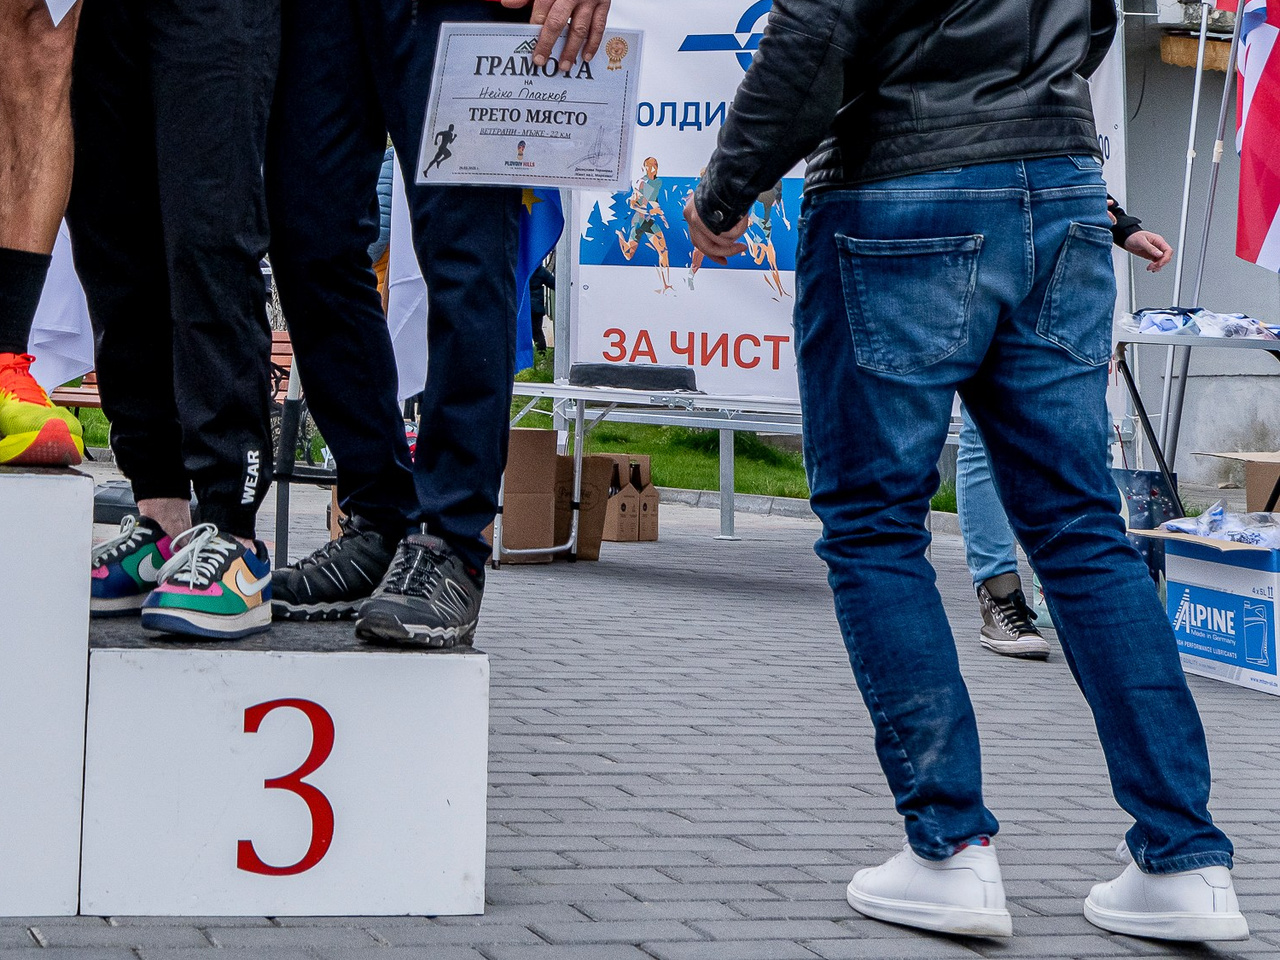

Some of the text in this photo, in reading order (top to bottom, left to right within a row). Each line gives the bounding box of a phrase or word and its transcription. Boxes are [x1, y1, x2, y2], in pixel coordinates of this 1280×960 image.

[469, 107, 588, 126] ТРЕТО МЯСТО
[637, 101, 733, 132] ОЛДИ
[480, 128, 517, 136] ВЕТЕРАНИ
[523, 129, 545, 138] МЪЖЕ
[602, 328, 789, 370] ЗА ЧИСТ
[241, 450, 260, 504] WEAR
[1173, 588, 1236, 635] ALPINE
[1184, 640, 1212, 654] PERFORMANCE
[1213, 647, 1237, 659] LUBRICANTS
[1191, 628, 1206, 638] Made
[1213, 634, 1236, 646] Germany
[237, 697, 336, 876] 3
